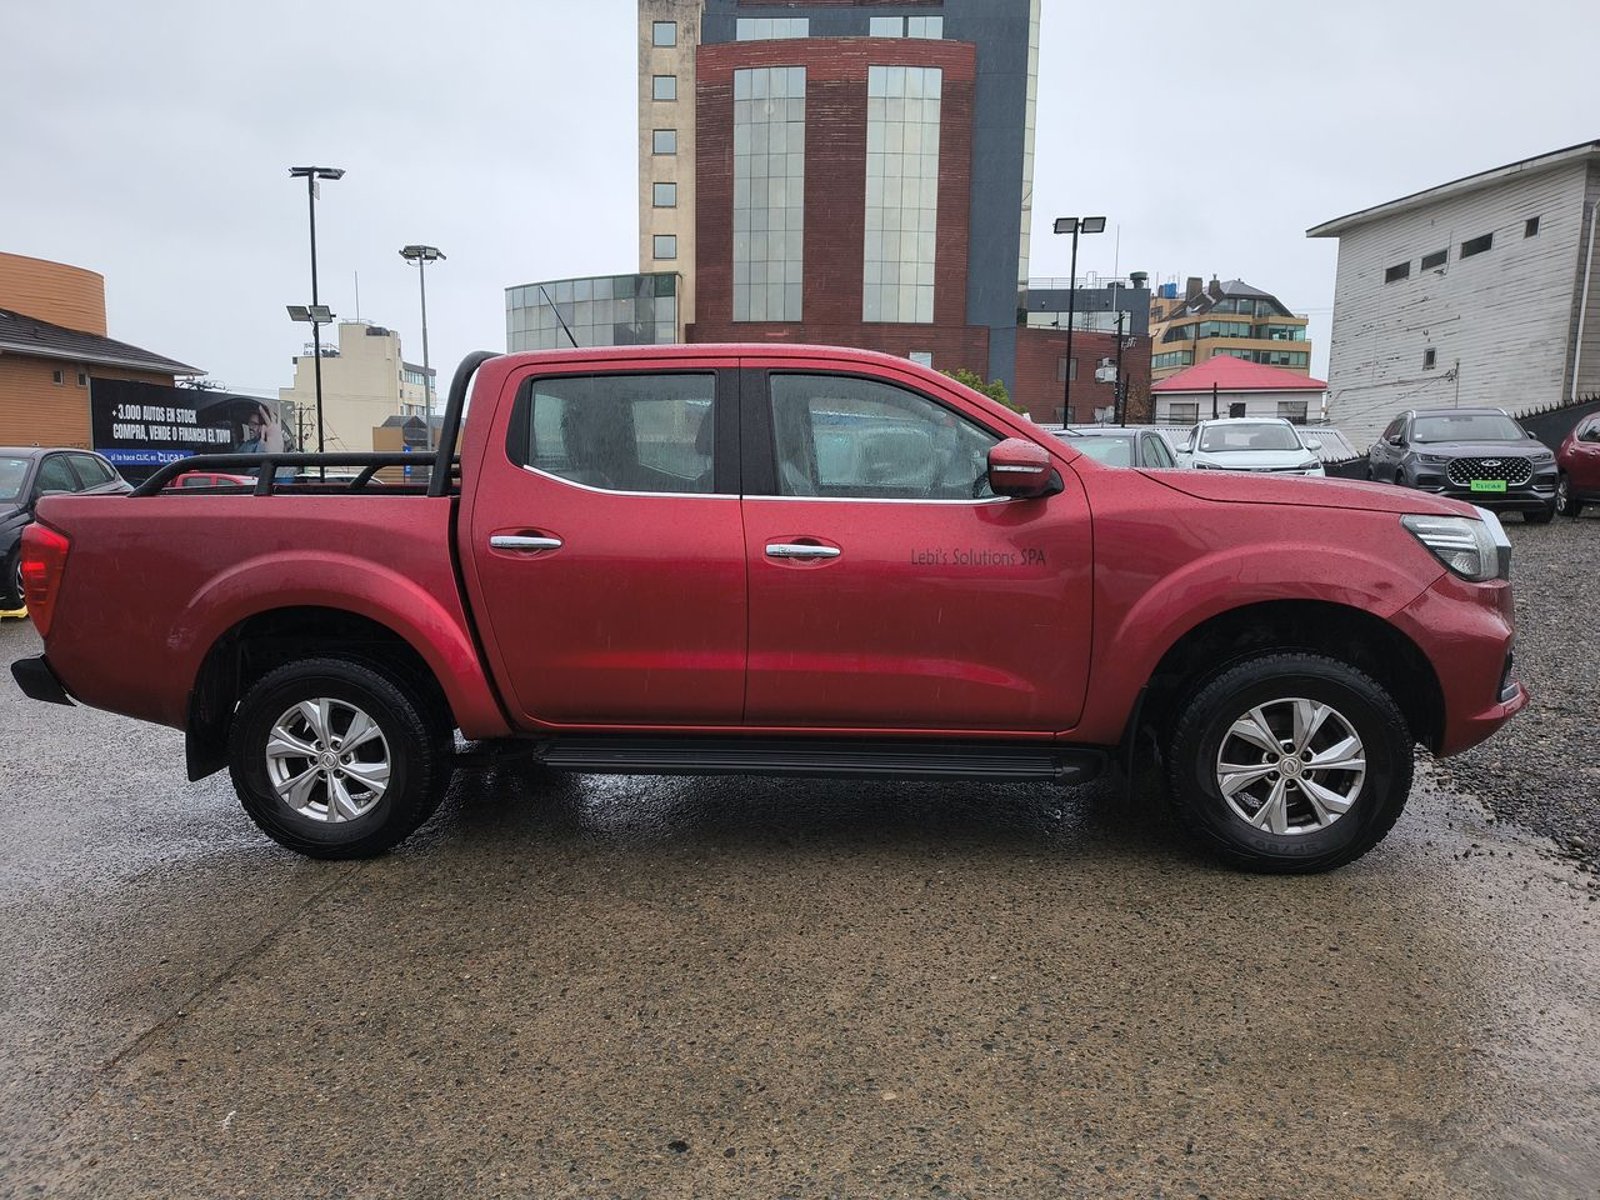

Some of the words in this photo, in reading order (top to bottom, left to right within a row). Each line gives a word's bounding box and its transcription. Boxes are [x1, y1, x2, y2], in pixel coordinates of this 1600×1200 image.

[118, 404, 141, 420] 3.000
[143, 405, 165, 422] AUTOS
[166, 407, 176, 423] EN
[176, 408, 197, 424] STOCK
[113, 423, 149, 442] COMPRA,
[149, 425, 171, 441] VENDE
[173, 426, 178, 441] O
[178, 426, 207, 442] FINANCIA
[208, 428, 215, 443] EL
[216, 429, 231, 443] TUYO
[911, 547, 948, 566] Lebi's
[953, 547, 1016, 566] Solutions
[1020, 548, 1047, 566] SPA
